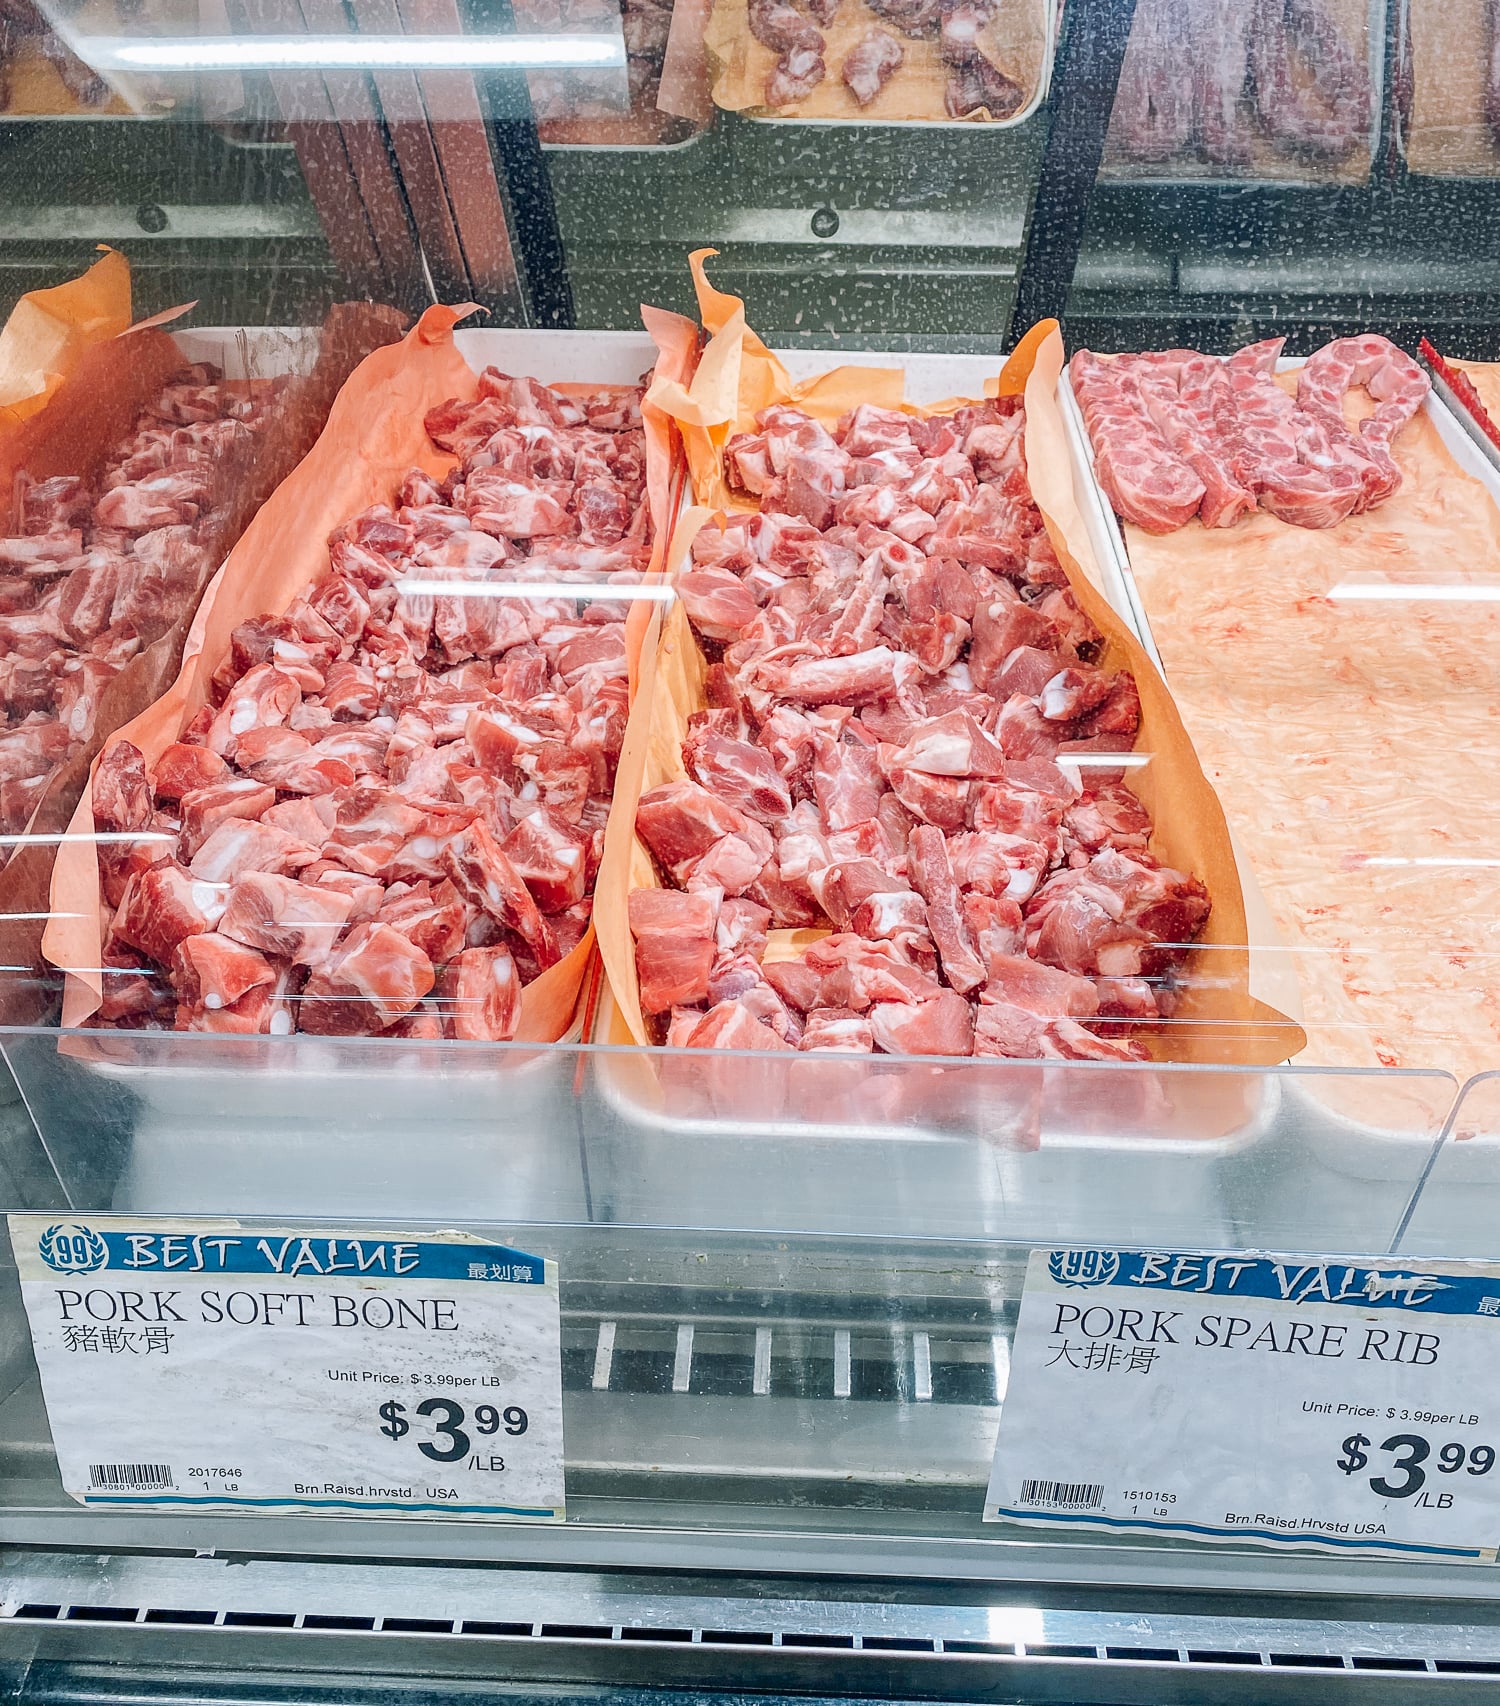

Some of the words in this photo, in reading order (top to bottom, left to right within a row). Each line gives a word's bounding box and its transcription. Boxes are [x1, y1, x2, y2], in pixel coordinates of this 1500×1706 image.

[56, 1235, 86, 1265] 99
[123, 1234, 242, 1272] BEST
[256, 1236, 420, 1278] VALUE
[467, 1262, 534, 1283] 最划算
[1067, 1251, 1099, 1278] 99
[1129, 1253, 1258, 1292] BEST
[55, 1289, 188, 1323] PORK
[201, 1290, 315, 1326] SOFT
[329, 1295, 459, 1331] BONE
[61, 1325, 175, 1354] 豬軟骨
[1050, 1303, 1184, 1344] PORK
[1195, 1315, 1348, 1358] SPARE
[1357, 1328, 1441, 1365] RIB
[1045, 1339, 1160, 1374] 大排骨
[328, 1370, 358, 1382] Unit
[362, 1372, 404, 1384] Price:
[481, 1376, 500, 1387] LB
[1302, 1401, 1332, 1414] Unit
[1336, 1403, 1380, 1417] Price:
[1459, 1415, 1479, 1425] LB
[188, 1467, 242, 1477] 2017646
[468, 1456, 505, 1471] /LB
[203, 1481, 210, 1490] 1
[224, 1483, 239, 1491] LB
[426, 1487, 459, 1499] USA
[1123, 1491, 1177, 1503] 1510153
[1414, 1492, 1454, 1509] /LB
[1131, 1505, 1138, 1515] 1
[1153, 1507, 1168, 1517] LB
[1354, 1524, 1386, 1534] USA
